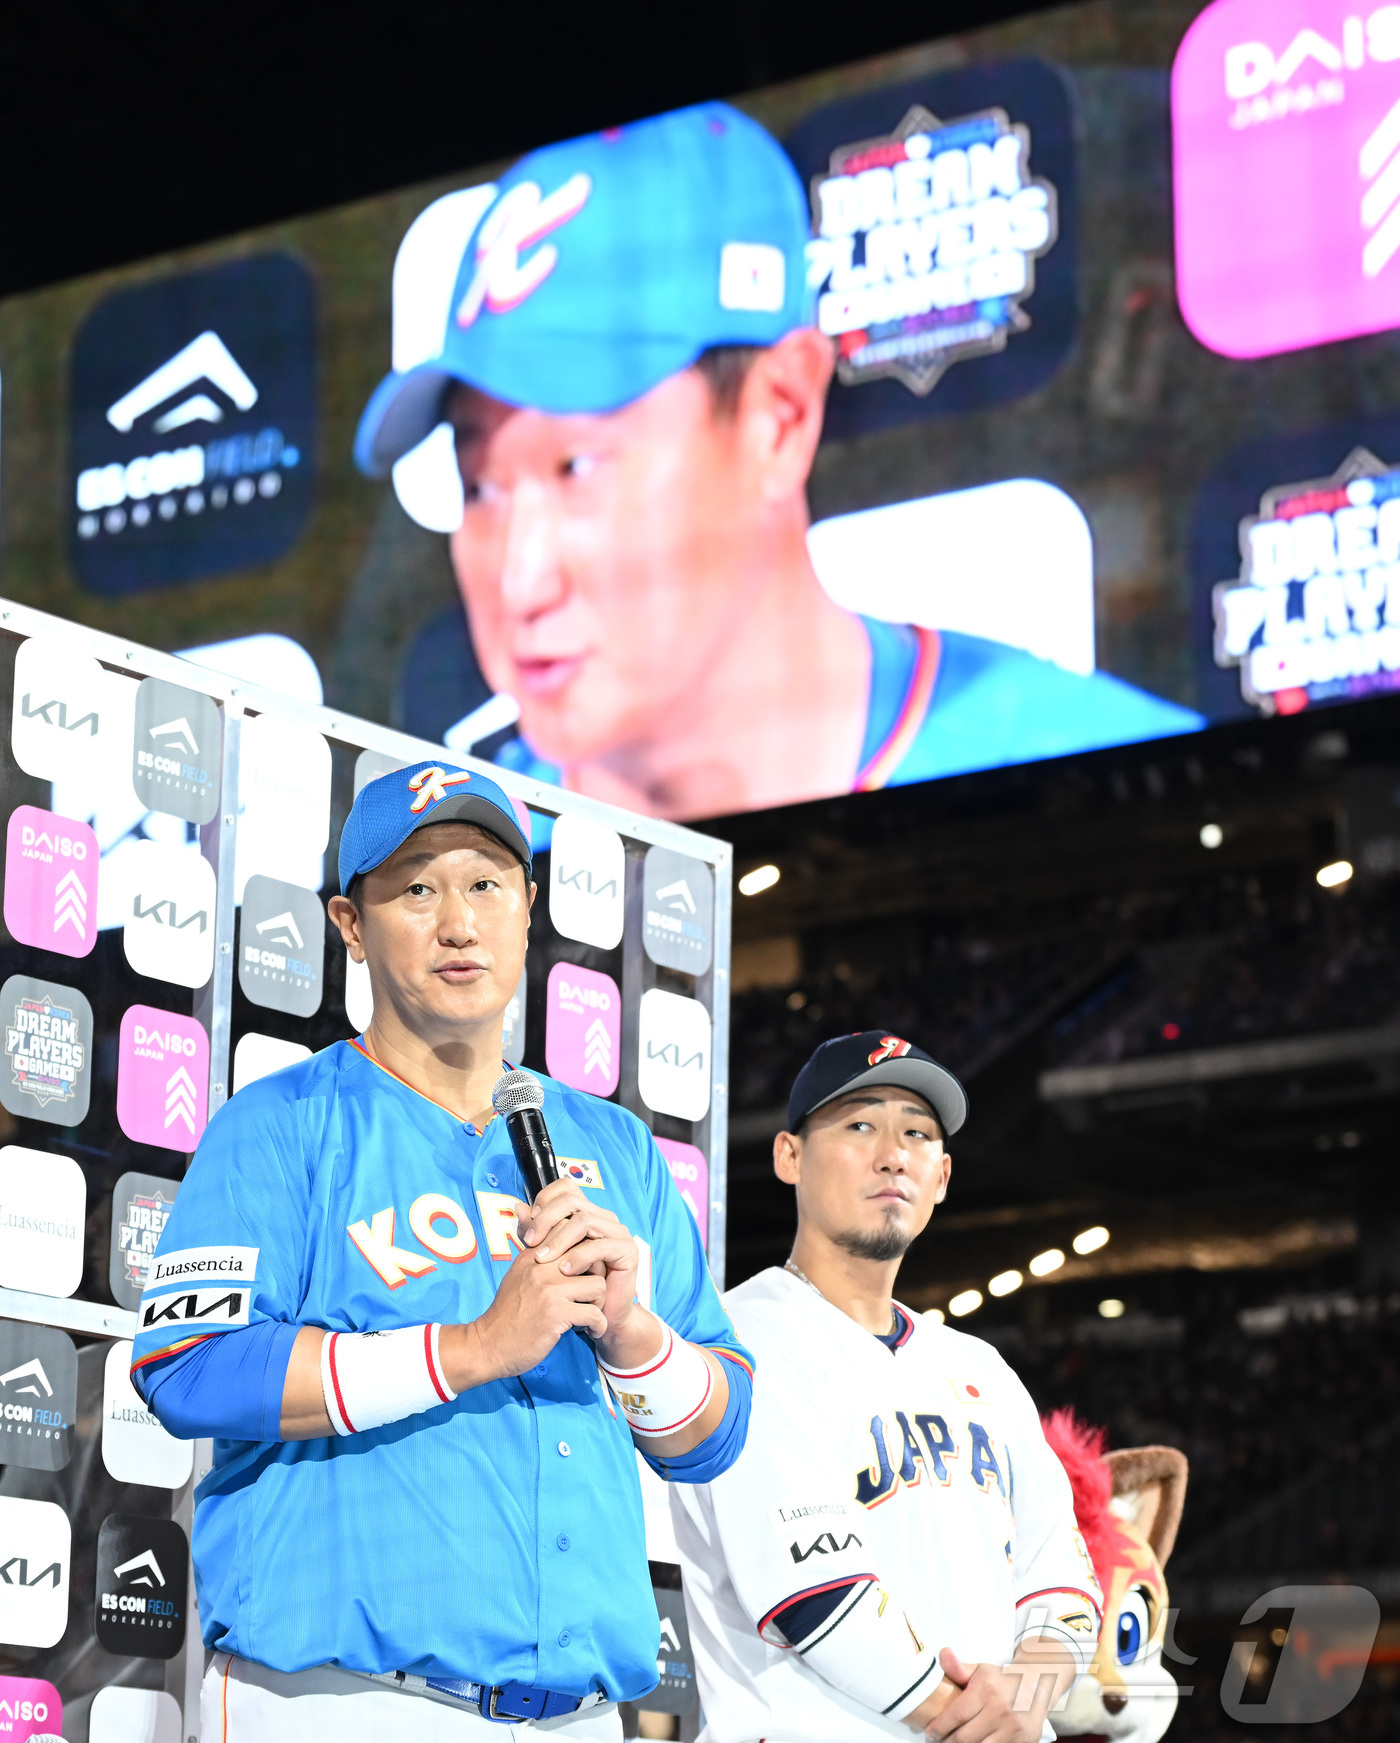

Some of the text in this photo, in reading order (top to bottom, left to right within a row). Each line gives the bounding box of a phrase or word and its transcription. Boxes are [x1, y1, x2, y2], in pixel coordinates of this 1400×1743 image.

[1225, 5, 1400, 100] DAIS
[819, 134, 1021, 240] DREAM
[1249, 497, 1400, 587] DREA
[21, 692, 99, 737] KIA
[137, 769, 206, 796] HOKKAIDO
[154, 756, 181, 777] CON
[409, 766, 470, 814] K
[21, 826, 87, 861] DAISO
[21, 848, 53, 864] JAPAN
[559, 865, 617, 899] KIA
[133, 893, 207, 934] KIA
[17, 1009, 76, 1044] DREAM
[134, 1025, 196, 1057] DAISO
[8, 1029, 83, 1068] PLAYERS
[134, 1047, 164, 1061] JAPAN
[647, 1039, 703, 1071] KIA
[29, 1058, 60, 1078] GAME
[154, 1256, 244, 1280] Luassencia
[143, 1292, 242, 1327] KIA
[0, 1422, 60, 1440] KKAIDO
[4, 1403, 33, 1423] CON
[34, 1408, 62, 1427] FIELD
[790, 1532, 863, 1564] KIA
[101, 1593, 174, 1616] ES CON FIELD
[101, 1613, 173, 1629] HOKKAIDO
[0, 1699, 48, 1722] AISO
